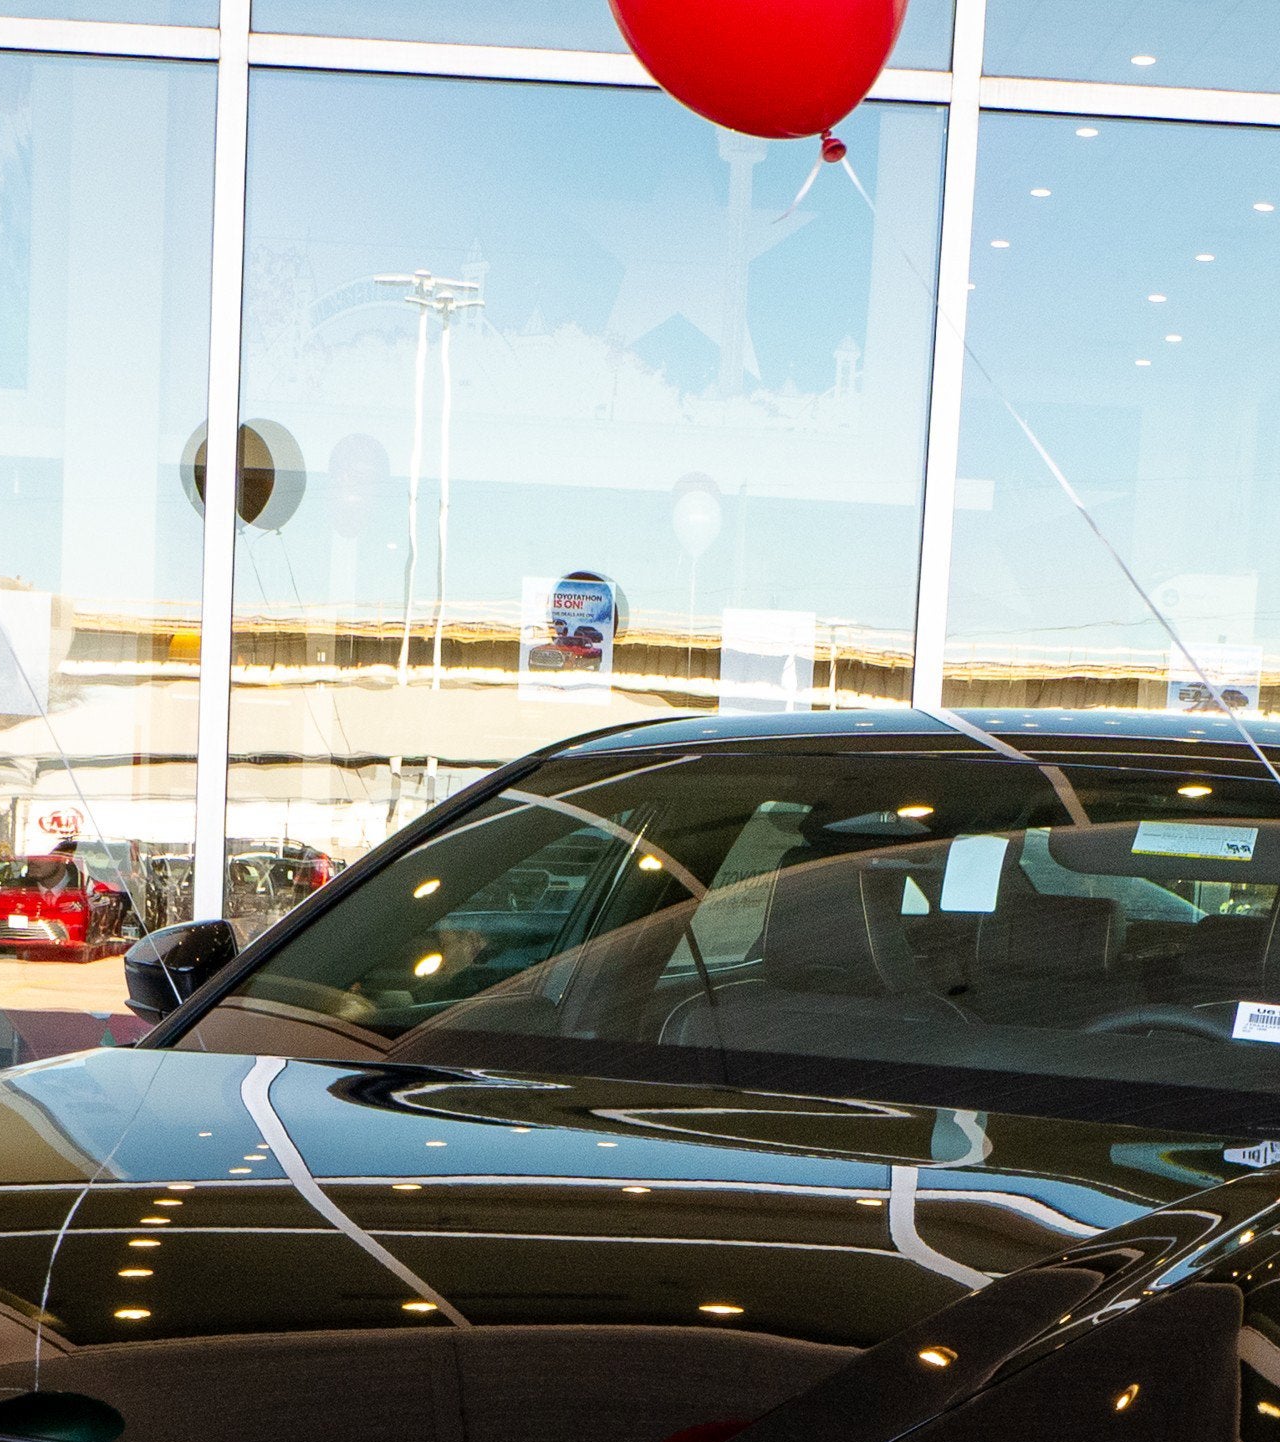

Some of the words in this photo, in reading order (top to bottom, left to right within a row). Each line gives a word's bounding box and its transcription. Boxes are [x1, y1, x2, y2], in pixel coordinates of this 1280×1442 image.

[553, 593, 603, 602] TOYOTATHON
[553, 600, 563, 608] IS
[564, 600, 583, 610] ON!
